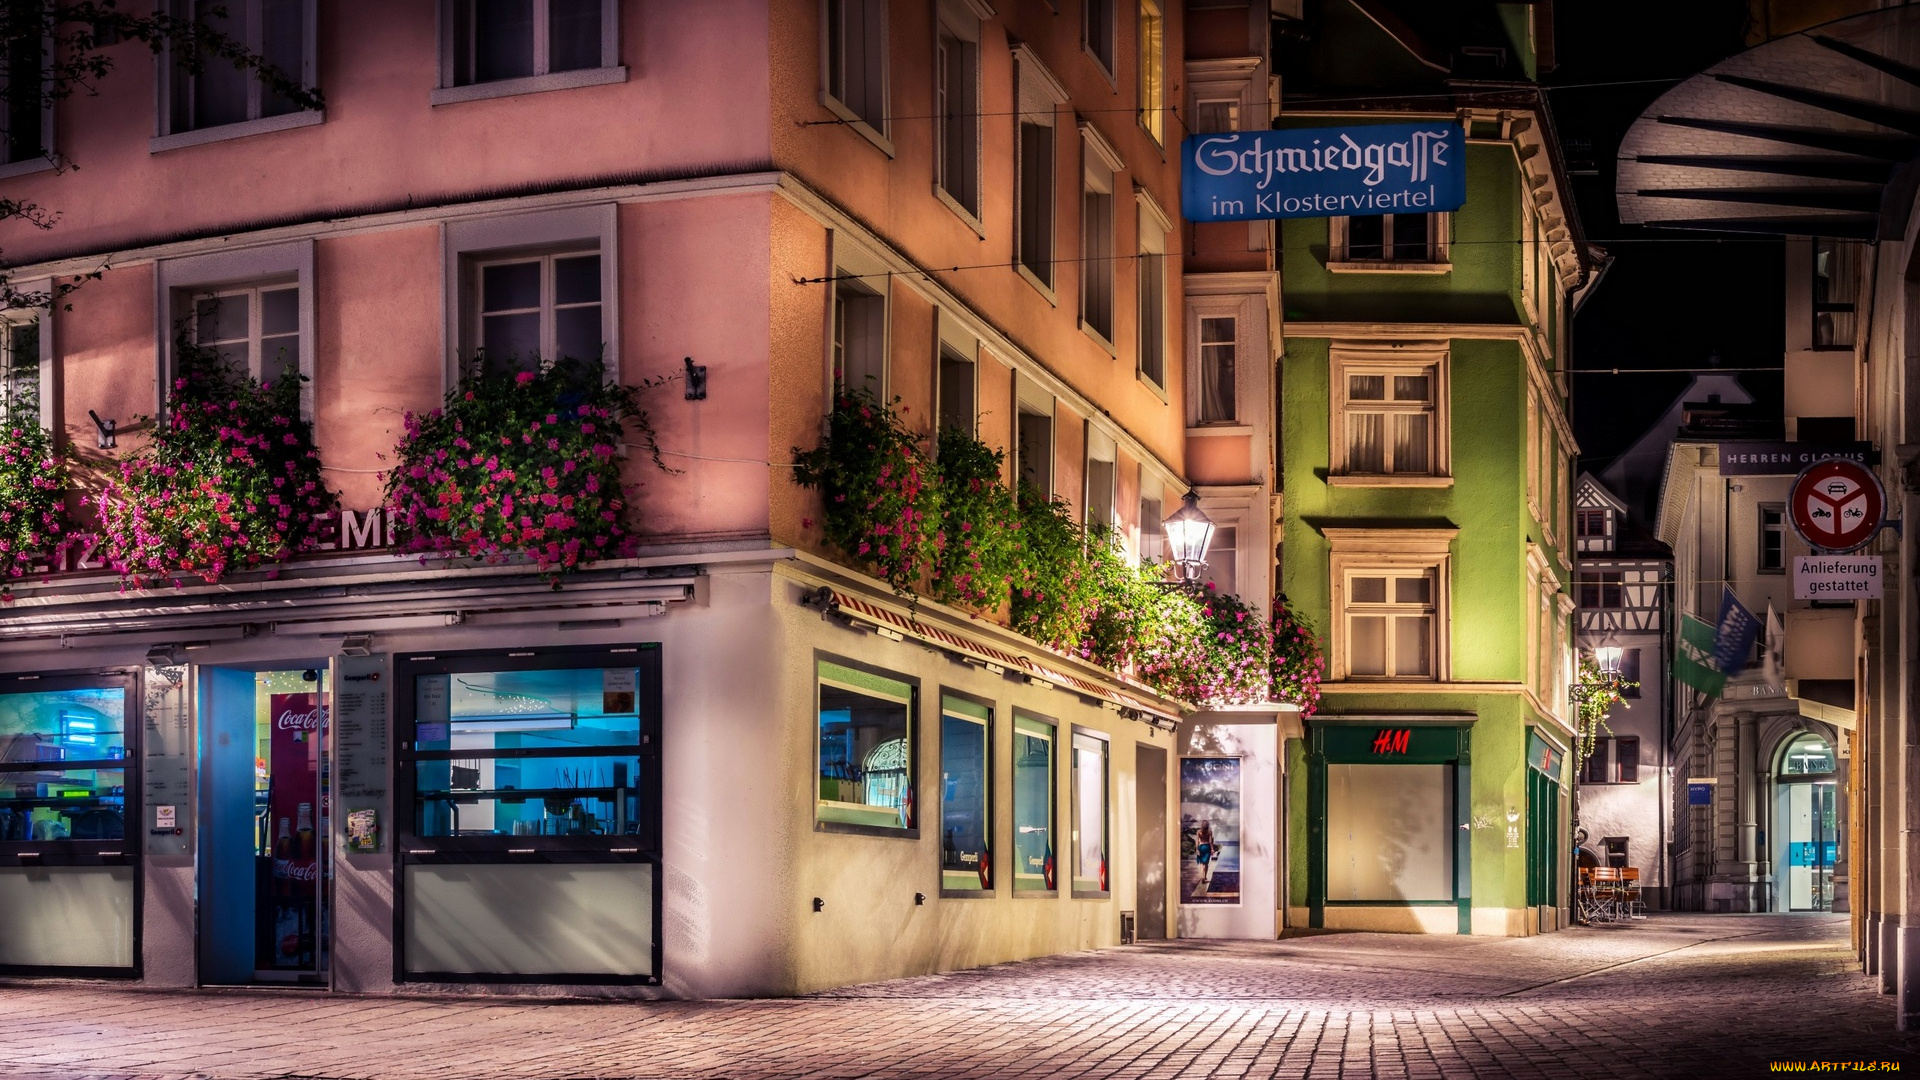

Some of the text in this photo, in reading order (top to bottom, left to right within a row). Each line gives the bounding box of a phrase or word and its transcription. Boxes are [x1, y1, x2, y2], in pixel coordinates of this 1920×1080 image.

[1212, 185, 1436, 216] im Klosterviertel
[1727, 453, 1792, 464] HERREN
[1800, 560, 1877, 577] Anlieferung
[1809, 579, 1869, 595] gestattet
[1373, 729, 1411, 755] H&M
